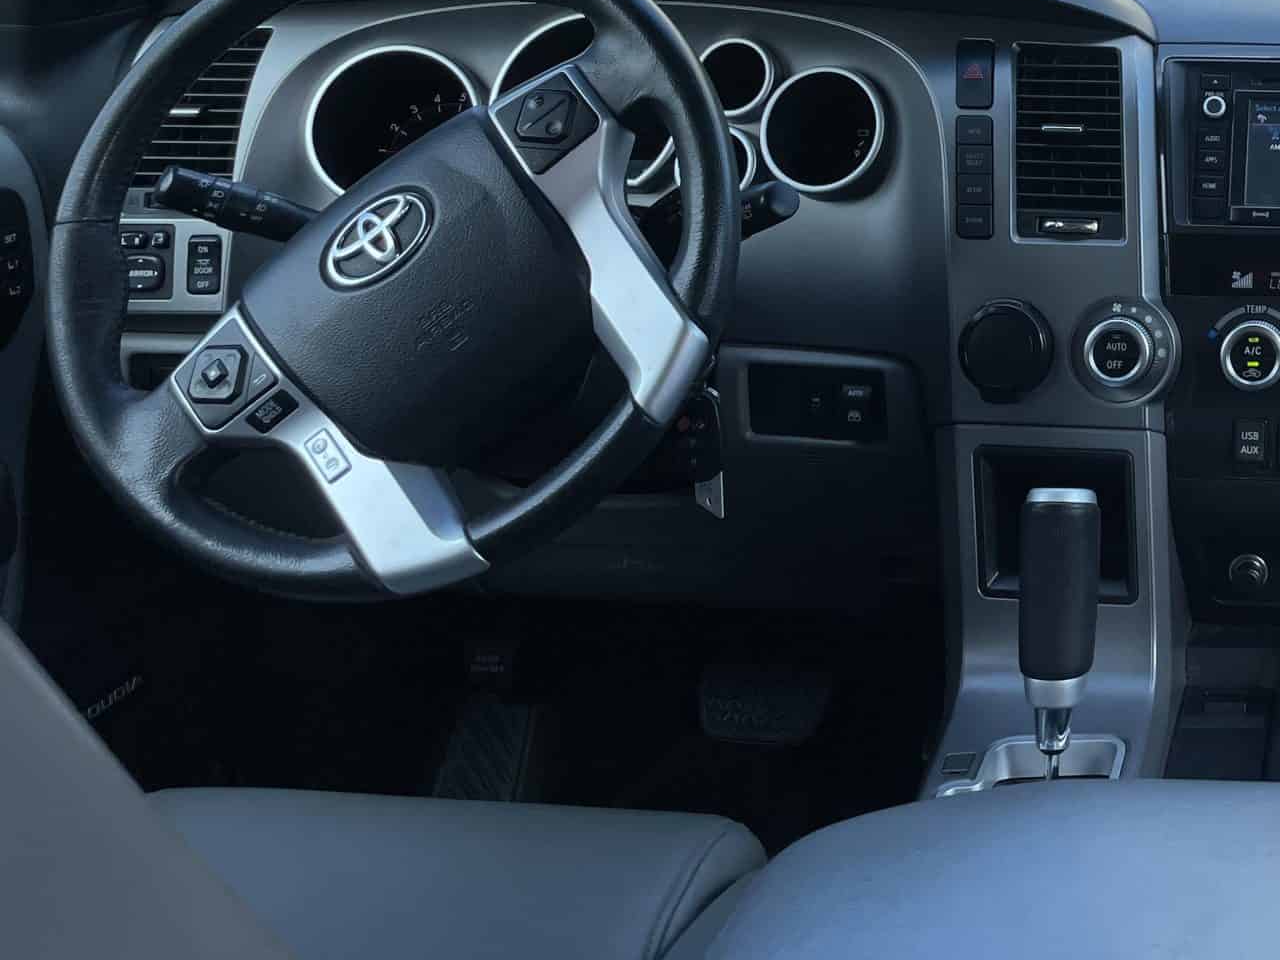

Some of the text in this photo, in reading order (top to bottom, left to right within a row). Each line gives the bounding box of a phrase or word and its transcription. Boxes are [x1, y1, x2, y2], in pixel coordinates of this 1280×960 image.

[1246, 304, 1267, 313] TEMP
[1106, 342, 1127, 351] AUTO
[1244, 346, 1262, 356] A/C
[1106, 360, 1123, 369] OFF
[1241, 431, 1259, 441] USB
[1240, 445, 1259, 455] AUX
